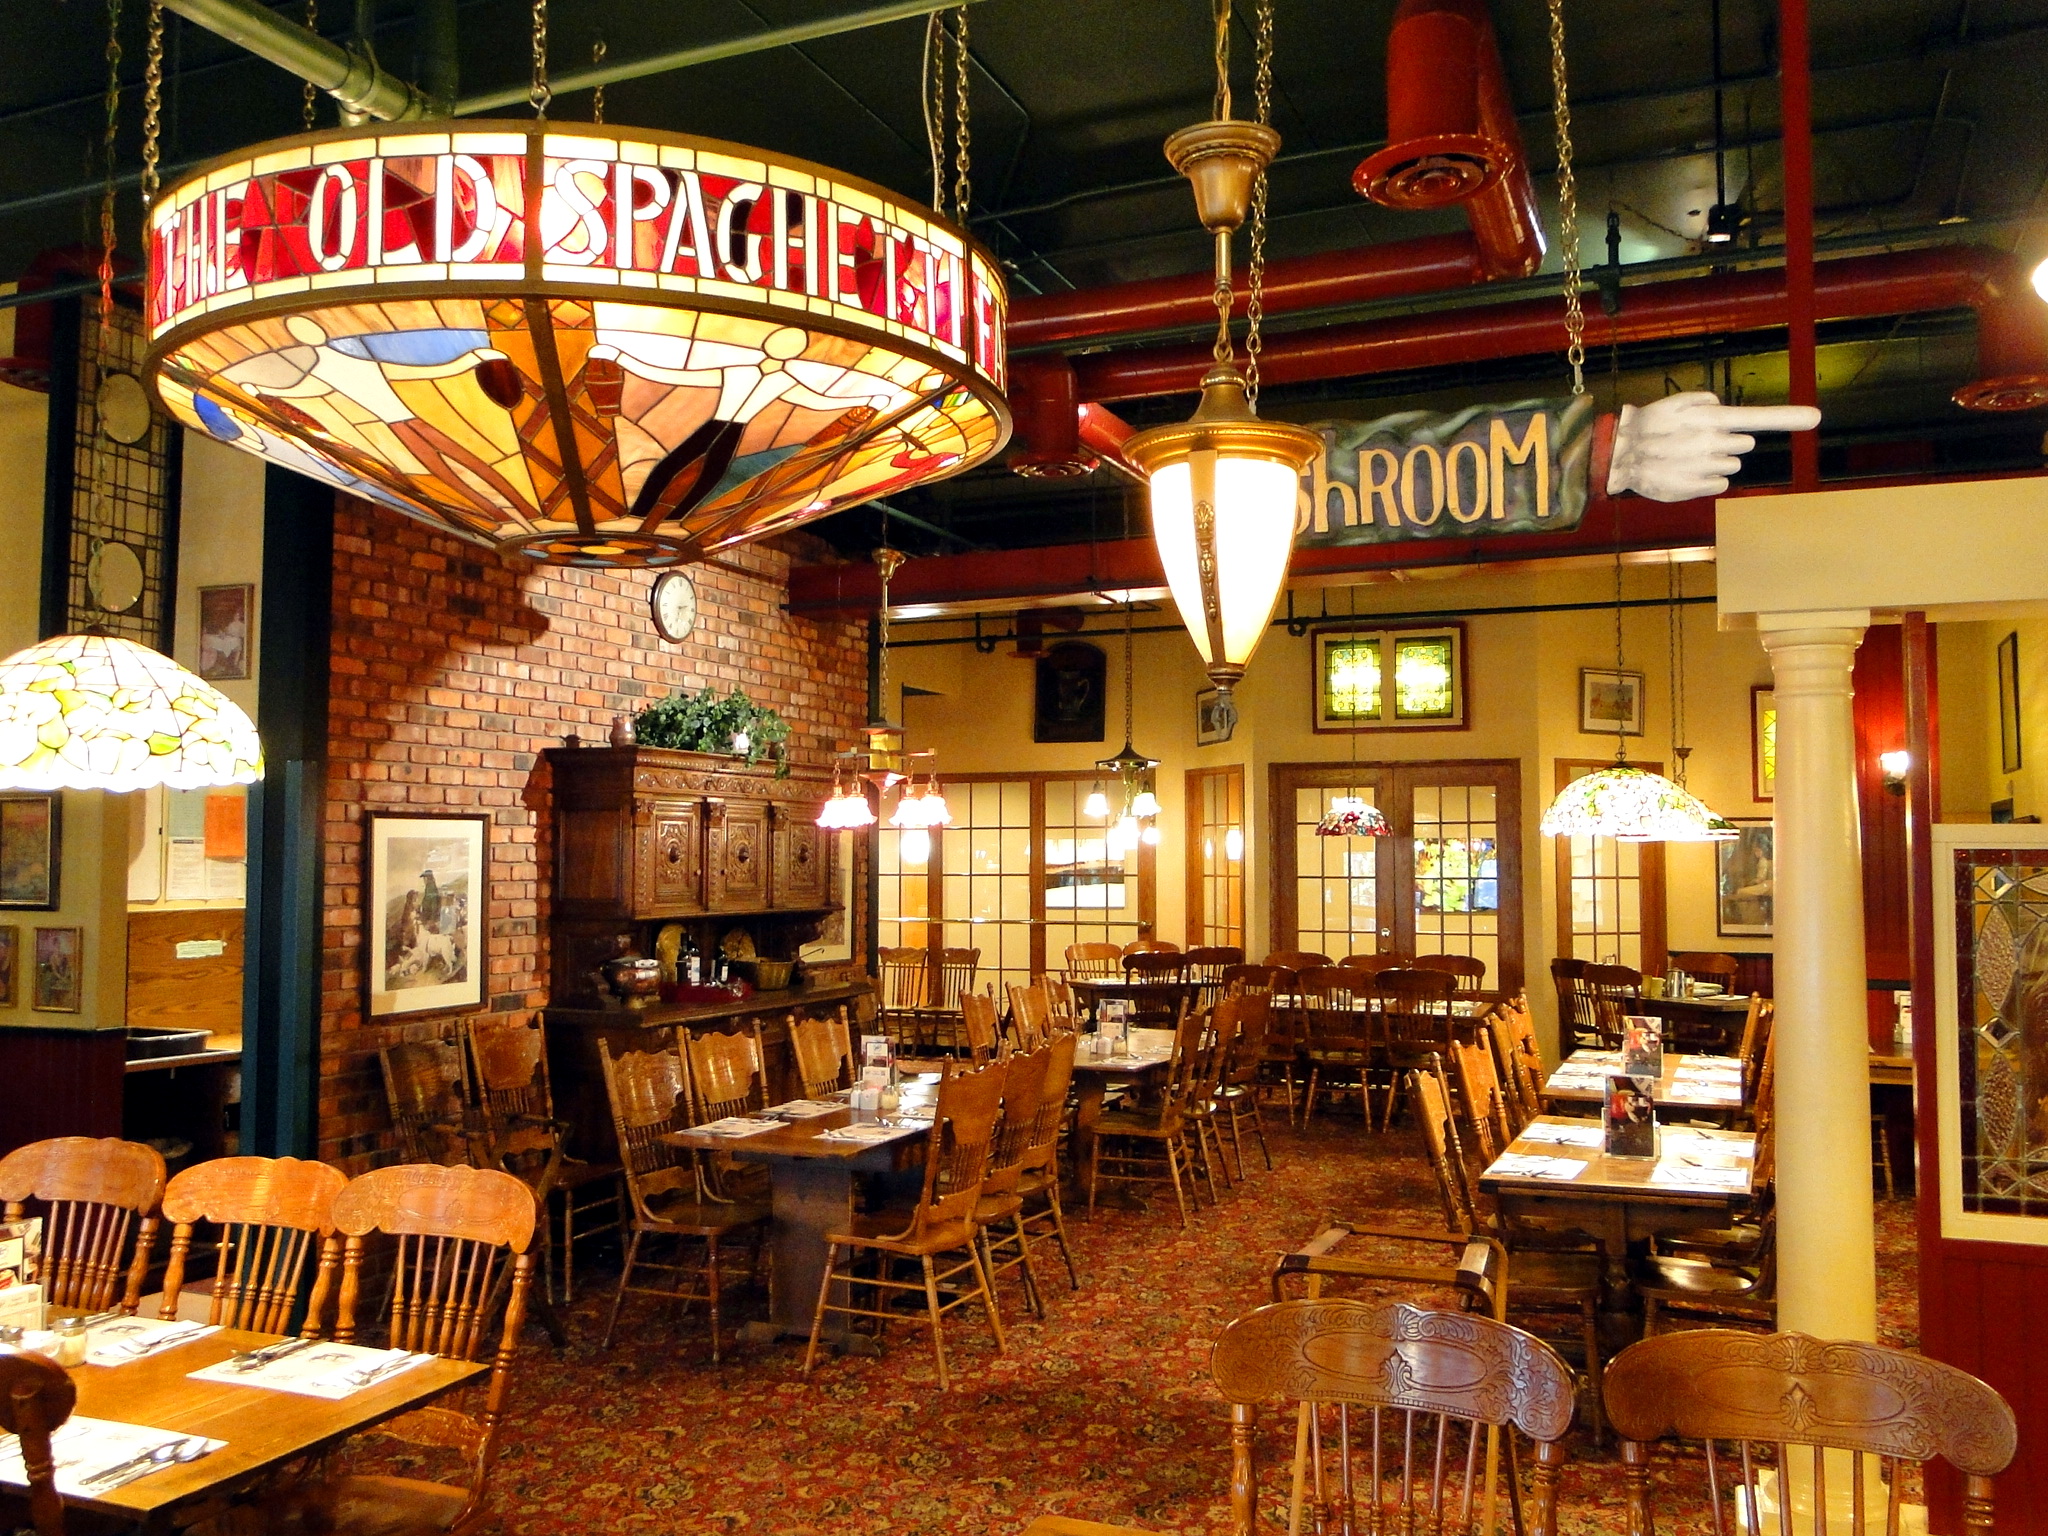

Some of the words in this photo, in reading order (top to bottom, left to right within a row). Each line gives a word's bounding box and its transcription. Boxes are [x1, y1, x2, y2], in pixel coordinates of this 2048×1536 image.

[161, 181, 249, 318] THE
[309, 154, 497, 271] OLD
[543, 159, 960, 348] SPAGHETTI
